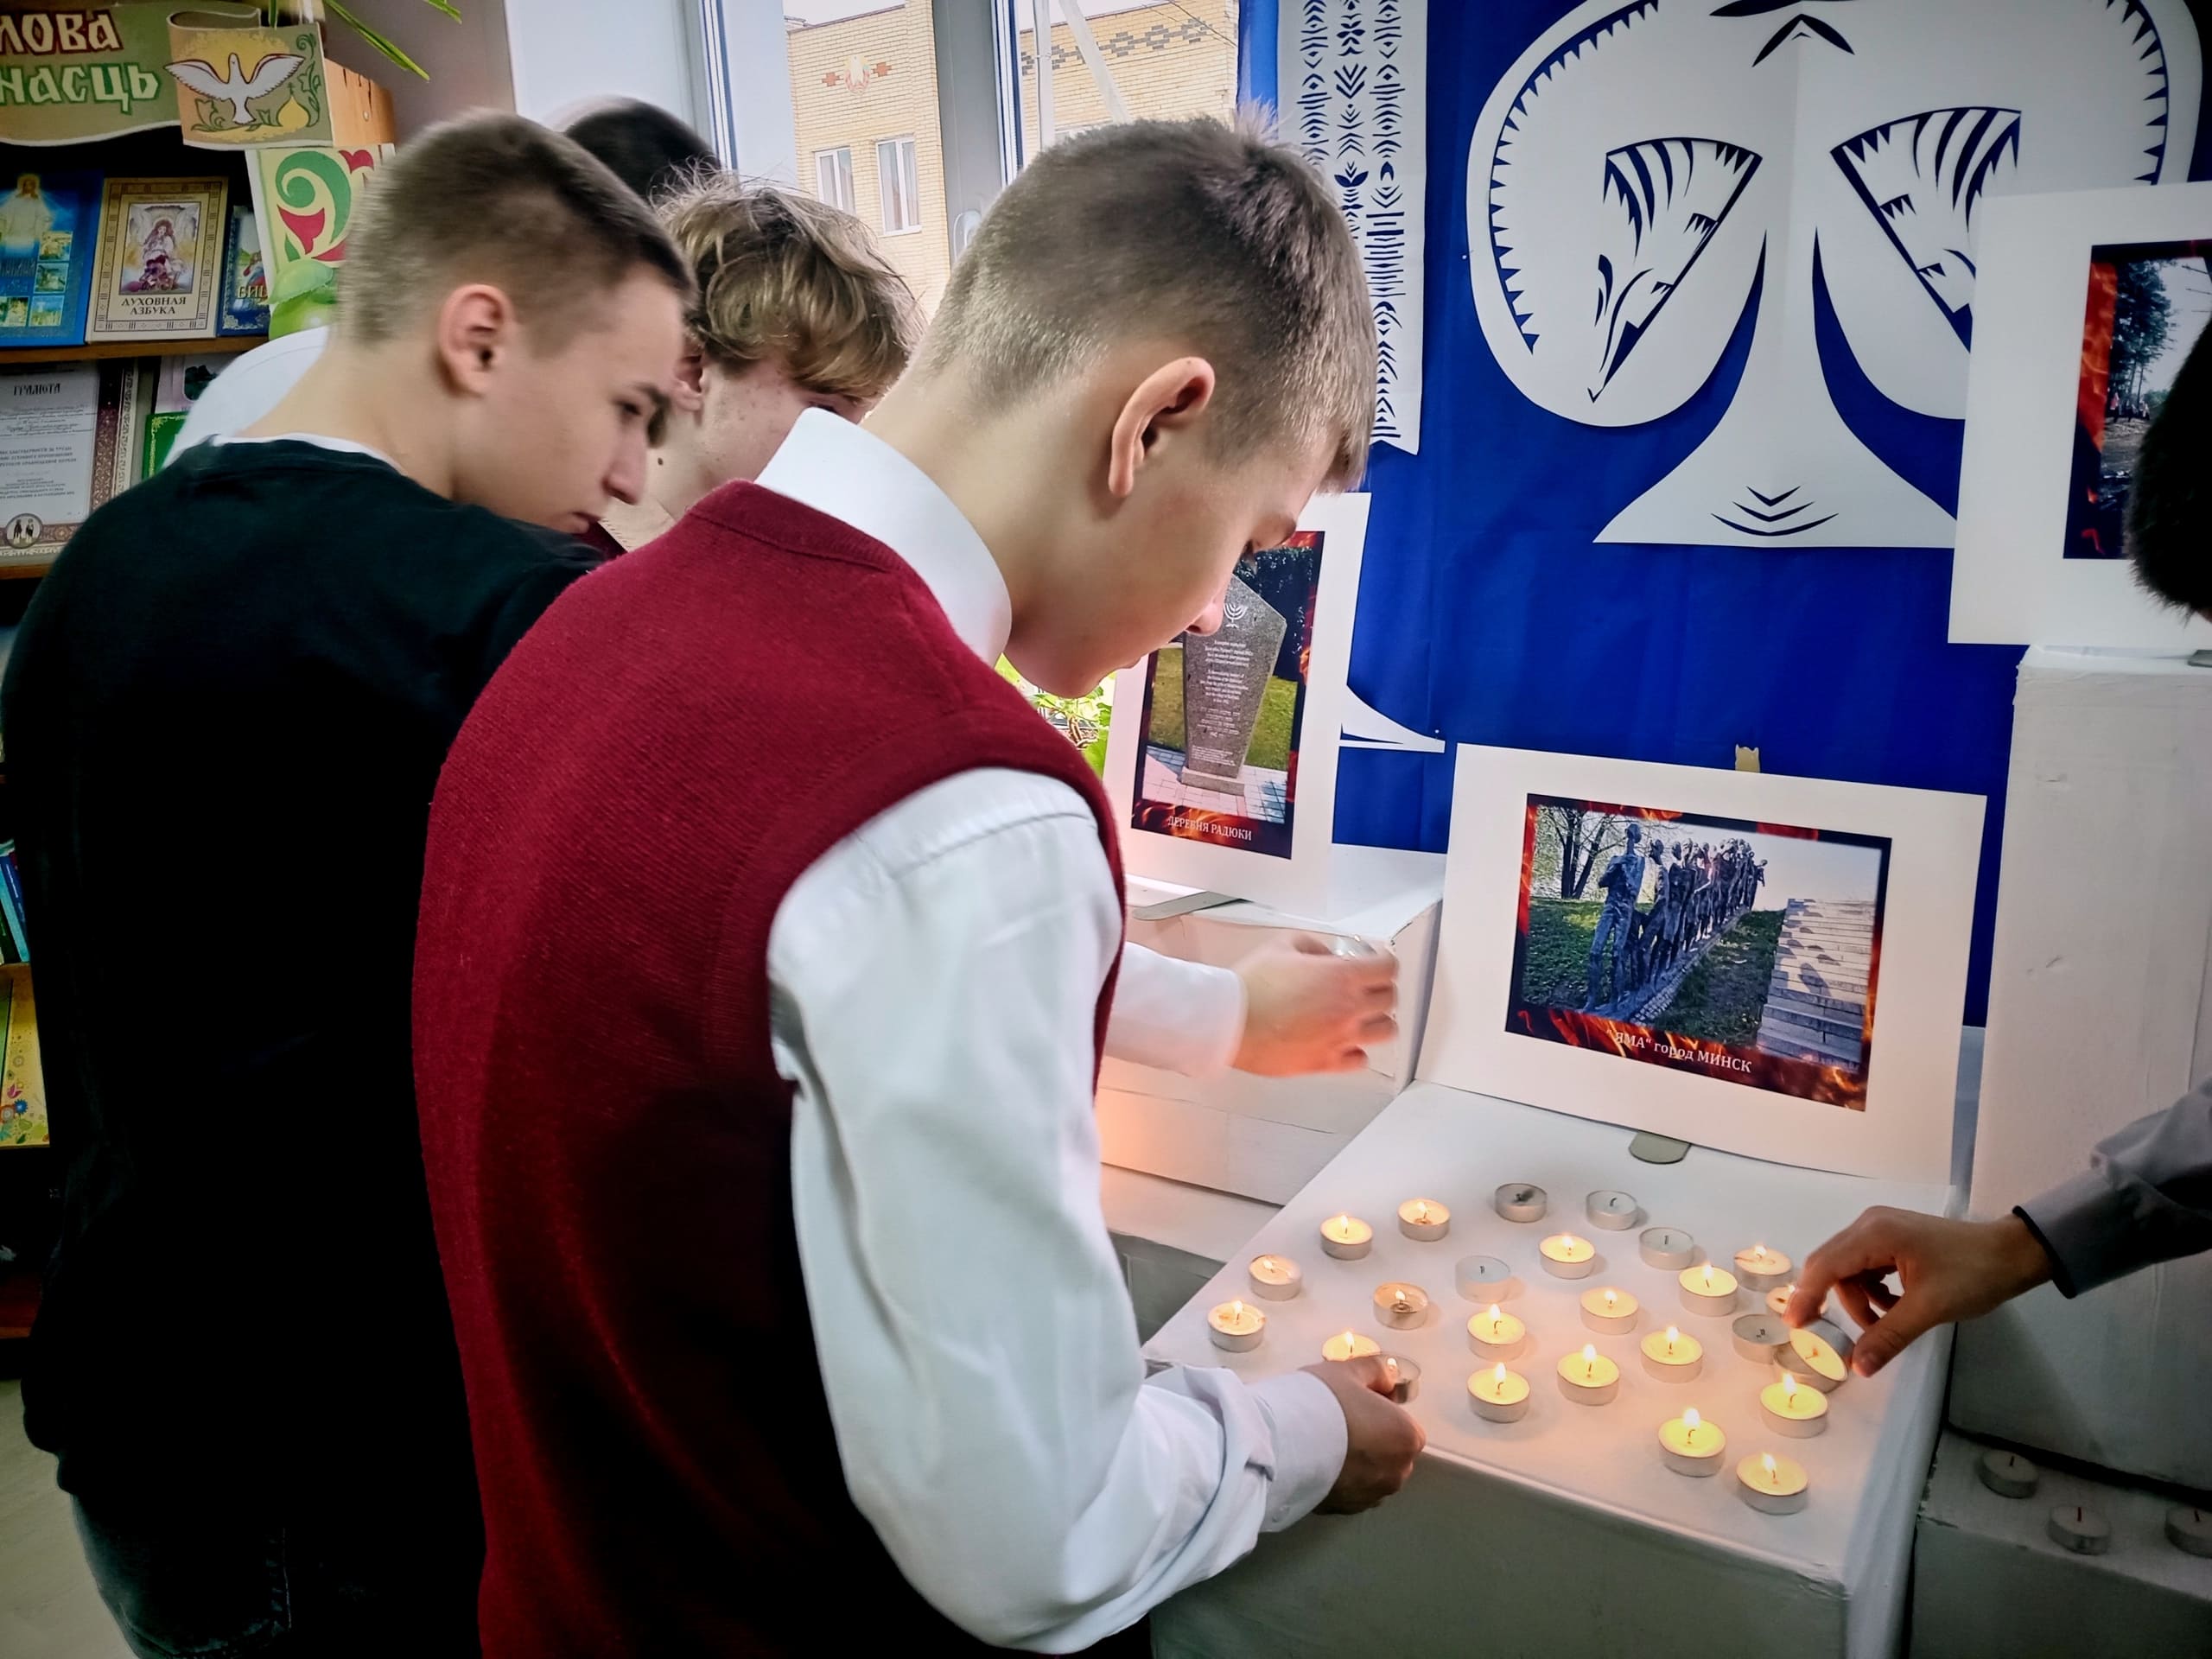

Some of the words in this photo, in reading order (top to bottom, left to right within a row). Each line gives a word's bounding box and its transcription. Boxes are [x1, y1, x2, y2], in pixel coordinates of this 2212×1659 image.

[121, 296, 187, 307] ДУХОВНАЯ
[130, 306, 176, 315] АЗБУКА
[1167, 815, 1210, 834] ДЕРЕВНЯ
[1211, 823, 1252, 842] РАДЮКИ
[1654, 1042, 1694, 1061] город
[1697, 1050, 1752, 1073] МИНСК
